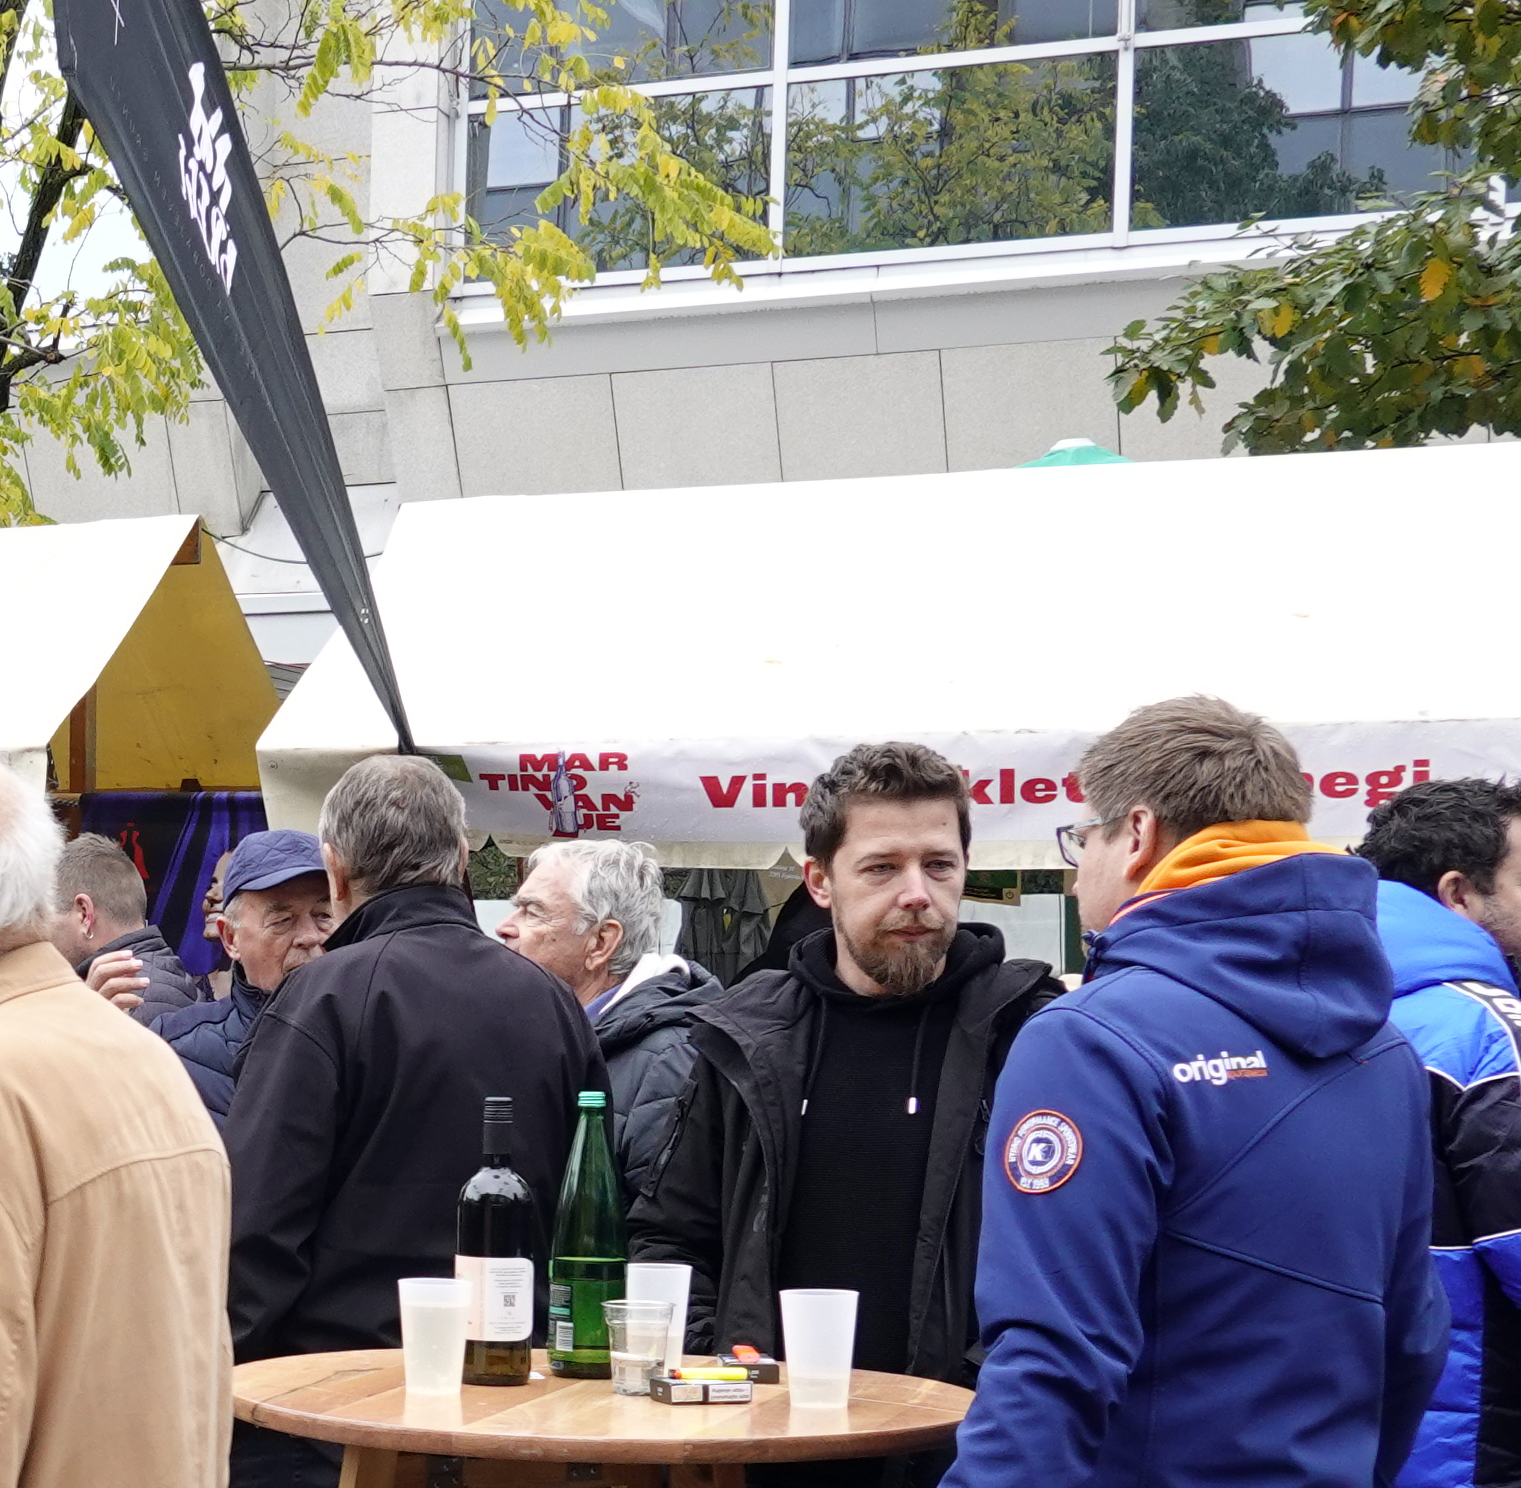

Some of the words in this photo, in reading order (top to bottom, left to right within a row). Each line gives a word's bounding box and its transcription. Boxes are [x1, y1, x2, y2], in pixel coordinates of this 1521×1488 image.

[519, 751, 629, 773] MAR
[1300, 759, 1431, 808] egi
[577, 812, 622, 832] JE
[1173, 1050, 1268, 1086] original
